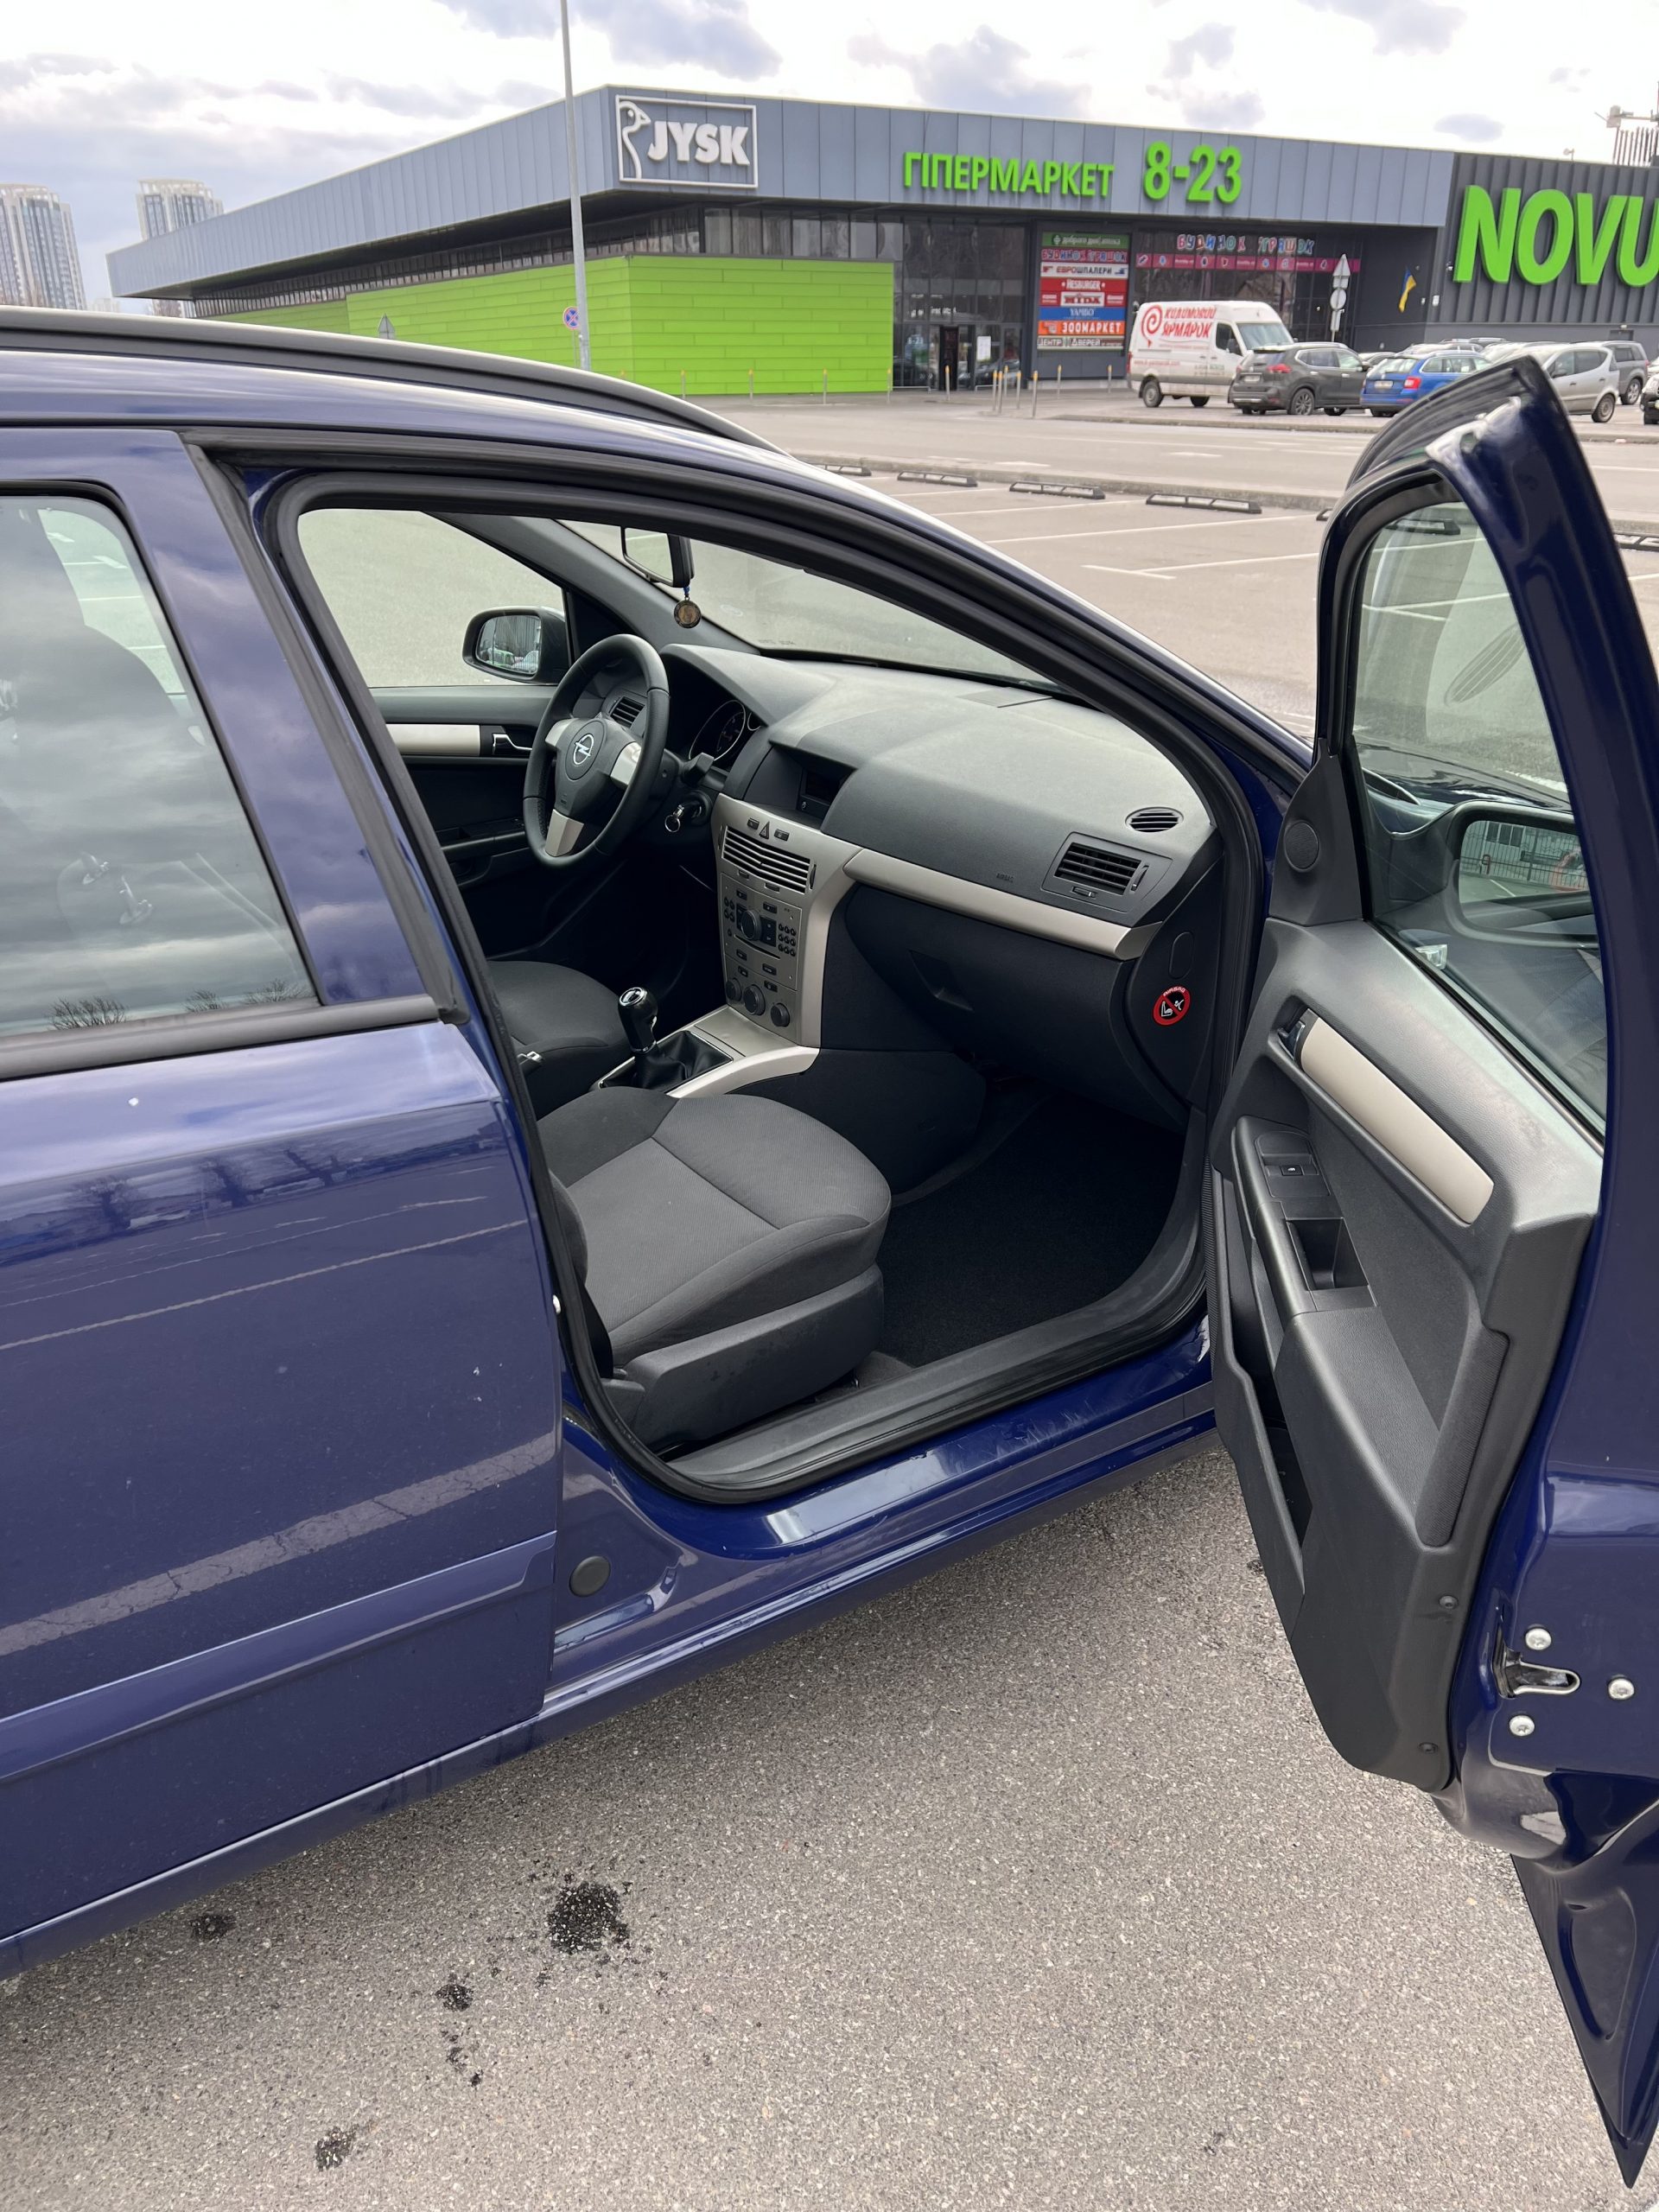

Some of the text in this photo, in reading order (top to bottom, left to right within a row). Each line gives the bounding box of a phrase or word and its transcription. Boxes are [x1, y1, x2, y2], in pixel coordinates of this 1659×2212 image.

[647, 120, 750, 165] JYSK
[903, 141, 1243, 203] ГІПЕРМАРКЕТ 8-23
[1177, 234, 1246, 252] БУДИНОК
[1453, 185, 1659, 287] NOVU
[1062, 322, 1122, 334] ЗООМАРКЕТ
[1162, 321, 1212, 338] ЯРМАРОК
